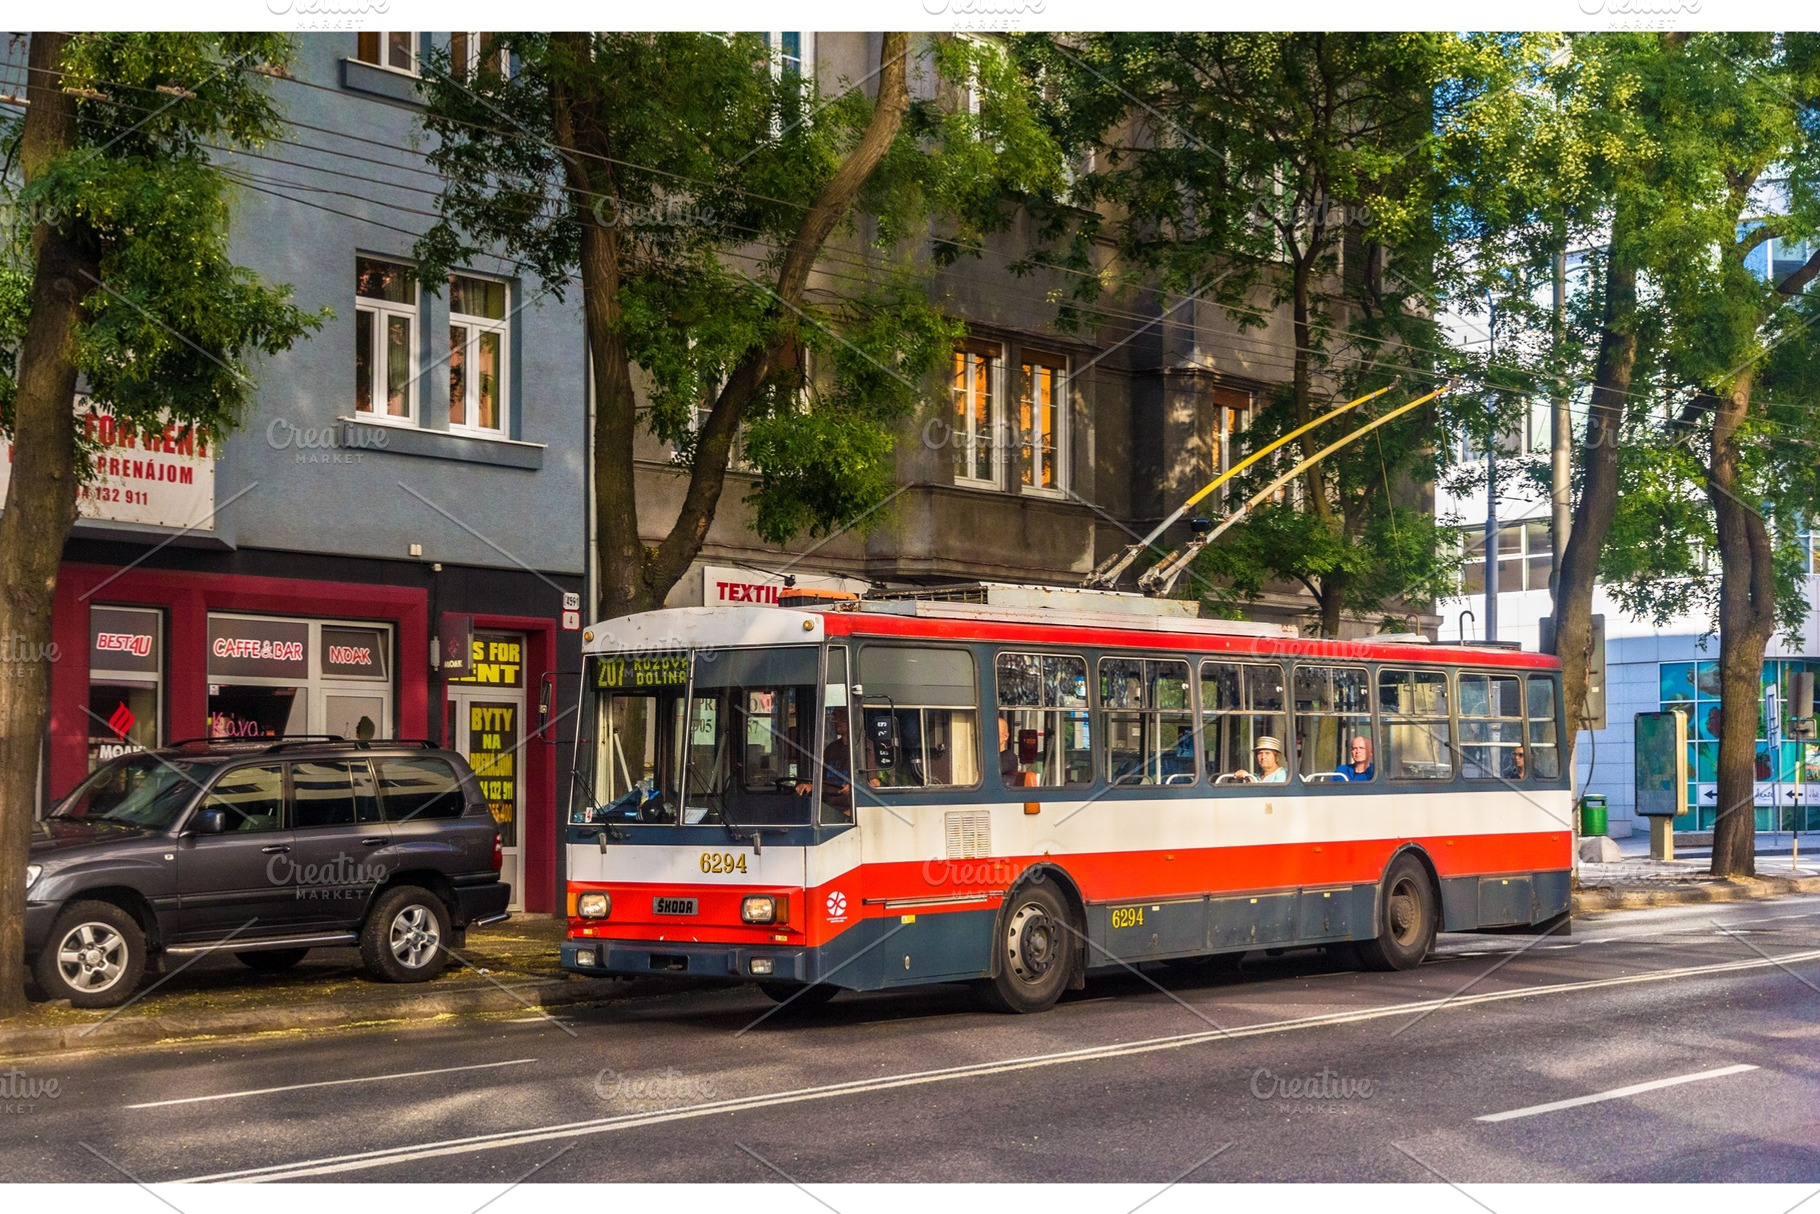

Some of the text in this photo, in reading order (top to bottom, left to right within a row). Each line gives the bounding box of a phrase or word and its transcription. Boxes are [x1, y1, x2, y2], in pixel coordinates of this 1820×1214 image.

[97, 456, 193, 485] PRENÁJOM
[96, 486, 119, 503] 132
[126, 490, 148, 506] 911
[717, 582, 792, 604] TEXTIL
[97, 633, 152, 656] BEST4U
[489, 642, 520, 662] FOR
[598, 657, 625, 687] 207
[636, 670, 687, 685] DOLINA
[471, 707, 513, 731] BYTY
[483, 734, 501, 749] NA
[700, 853, 747, 874] 6294
[657, 898, 693, 914] ŠKODA
[1112, 907, 1144, 928] 6294
